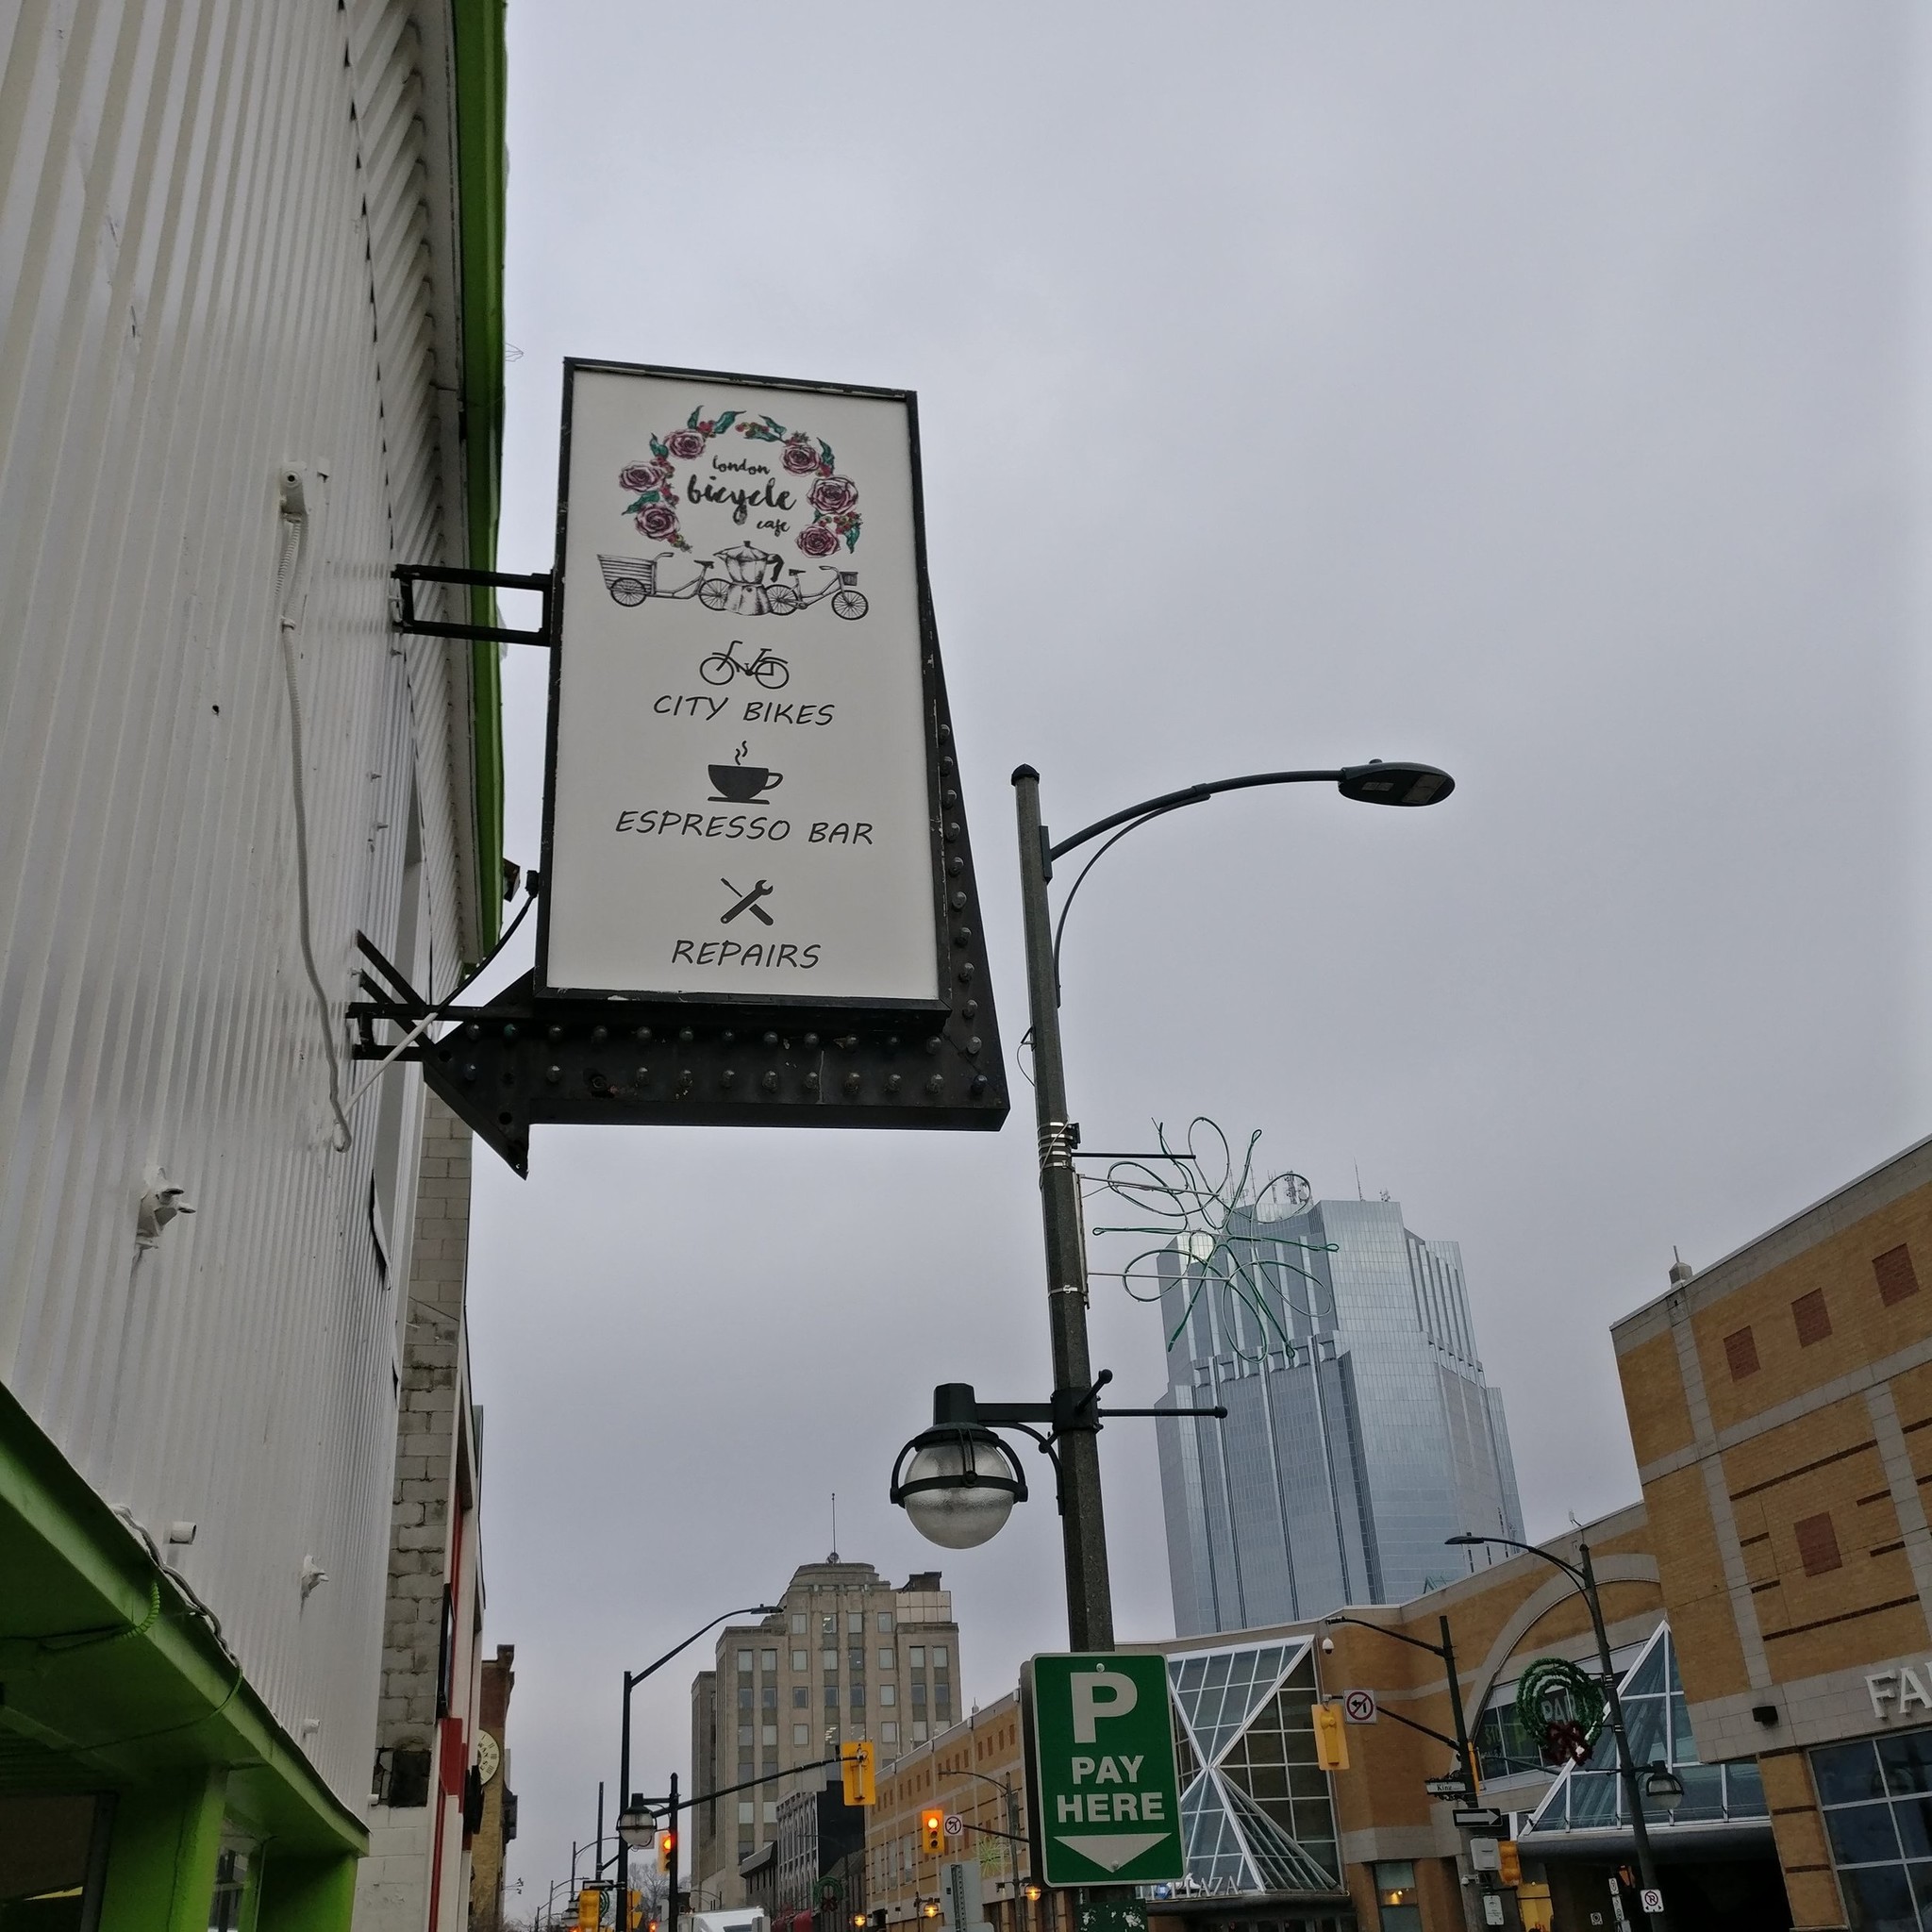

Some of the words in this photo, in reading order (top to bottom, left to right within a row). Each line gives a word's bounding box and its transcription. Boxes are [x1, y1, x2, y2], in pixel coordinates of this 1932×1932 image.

[711, 455, 771, 475] london
[687, 475, 798, 525] bicycle
[756, 518, 791, 537] cafe
[653, 694, 729, 722] CITY
[742, 701, 836, 726] BIKES
[615, 809, 791, 841] ESPRESSO
[808, 822, 874, 845] BAR
[671, 939, 822, 970] REPAIRS
[1864, 1660, 1932, 1719] FA
[1070, 1671, 1139, 1744] P
[1072, 1755, 1144, 1785] PAY
[1057, 1792, 1165, 1823] HERE
